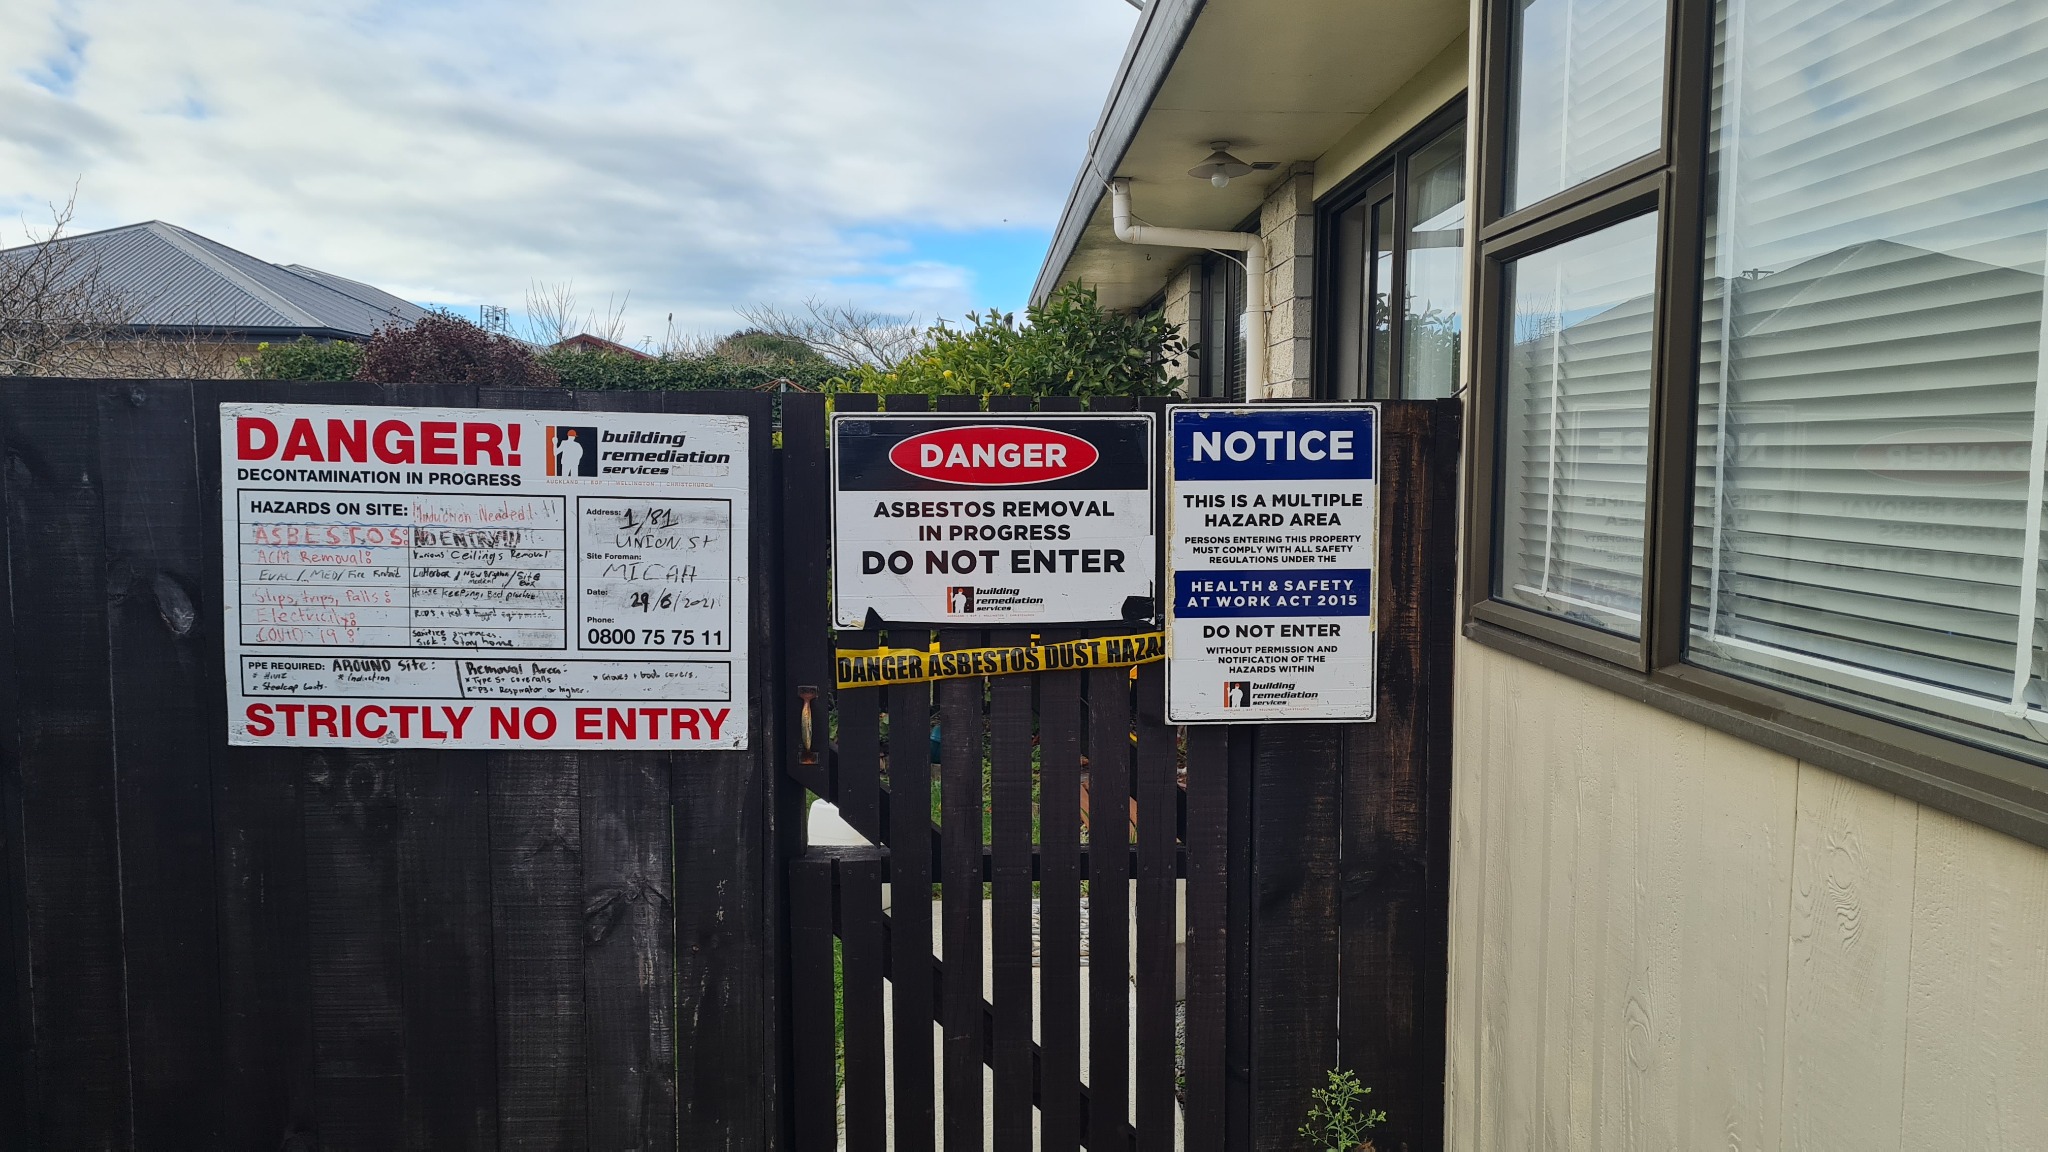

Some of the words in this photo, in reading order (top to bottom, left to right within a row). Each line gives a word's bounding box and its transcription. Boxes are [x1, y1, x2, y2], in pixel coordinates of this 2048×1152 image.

[237, 416, 521, 467] DANGER!
[601, 430, 686, 448] building
[1192, 430, 1354, 462] NOTICE
[601, 450, 731, 464] remediation
[919, 443, 1068, 469] DANGER
[602, 465, 669, 475] services
[237, 468, 401, 484] DECONTAMINATION
[406, 472, 423, 485] IN
[428, 473, 521, 487] PROGRESS
[1183, 494, 1226, 508] THIS
[1231, 494, 1248, 508] IS
[1253, 494, 1267, 508] A
[1272, 493, 1363, 507] MULTIPLE
[250, 501, 331, 515] HAZARDS
[336, 503, 361, 515] ON
[366, 503, 408, 517] SITE:
[586, 508, 621, 516] Address:
[873, 501, 996, 518] ASBESTOS
[1002, 500, 1115, 517] REMOVAL
[1204, 513, 1284, 527] HAZARD
[1290, 513, 1342, 526] AREA
[414, 529, 437, 547] NO
[918, 525, 942, 541] IN
[949, 524, 1071, 541] PROGRESS
[1185, 536, 1231, 544] PERSONS
[1233, 536, 1283, 544] ENTERING
[1285, 535, 1307, 543] THIS
[1309, 535, 1362, 543] PROPERTY
[616, 534, 682, 549] UNION
[1193, 546, 1220, 554] MUST
[1222, 546, 1264, 554] COMPLY
[1265, 545, 1292, 553] WITH
[1294, 545, 1313, 553] ALL
[1315, 545, 1353, 553] SAFETY
[258, 550, 290, 564] ACM
[450, 550, 503, 565] Ceilings
[511, 551, 549, 559] Removal
[862, 550, 914, 575] DO
[925, 550, 1000, 575] NOT
[1010, 549, 1126, 574] ENTER
[1209, 556, 1279, 564] REGULATIONS
[1281, 555, 1314, 563] UNDER
[1318, 555, 1337, 563] THE
[603, 561, 697, 583] MICAH
[586, 588, 608, 596] Date:
[976, 587, 1020, 596] building
[1191, 580, 1263, 592] HEALTH
[1268, 580, 1279, 592] &
[1284, 579, 1354, 591] SAFETY
[976, 596, 1044, 604] remediation
[1187, 596, 1211, 608] AT
[1216, 596, 1271, 607] WORK
[1276, 595, 1312, 607] ACT
[1317, 595, 1357, 606] 2015
[586, 616, 615, 624] Phone:
[587, 628, 636, 645] 0800
[642, 629, 665, 646] 75
[671, 629, 695, 646] 75
[701, 629, 722, 646] 11
[1203, 625, 1231, 639] DO
[1235, 624, 1275, 638] NOT
[1280, 624, 1341, 638] ENTER
[1206, 646, 1253, 654] WITHOUT
[1255, 646, 1315, 654] PERMISSION
[1316, 645, 1338, 653] AND
[248, 661, 268, 670] PPE
[270, 661, 325, 671] REQUIRED:
[332, 659, 392, 672] AROUND
[837, 655, 923, 683] DANGER
[929, 646, 1040, 677] ASBESTOS
[1044, 640, 1100, 669] DUST
[1106, 635, 1165, 664] HAZA
[1218, 656, 1289, 664] NOTIFICATION
[1291, 655, 1304, 663] OF
[1307, 655, 1326, 663] THE
[465, 662, 523, 675] Removal
[1278, 665, 1315, 673] WITHIN
[1252, 682, 1296, 691] building
[1252, 691, 1319, 699] remediation
[245, 703, 474, 740] STRICTLY
[489, 706, 558, 740] NO
[575, 707, 731, 741] ENTRY
